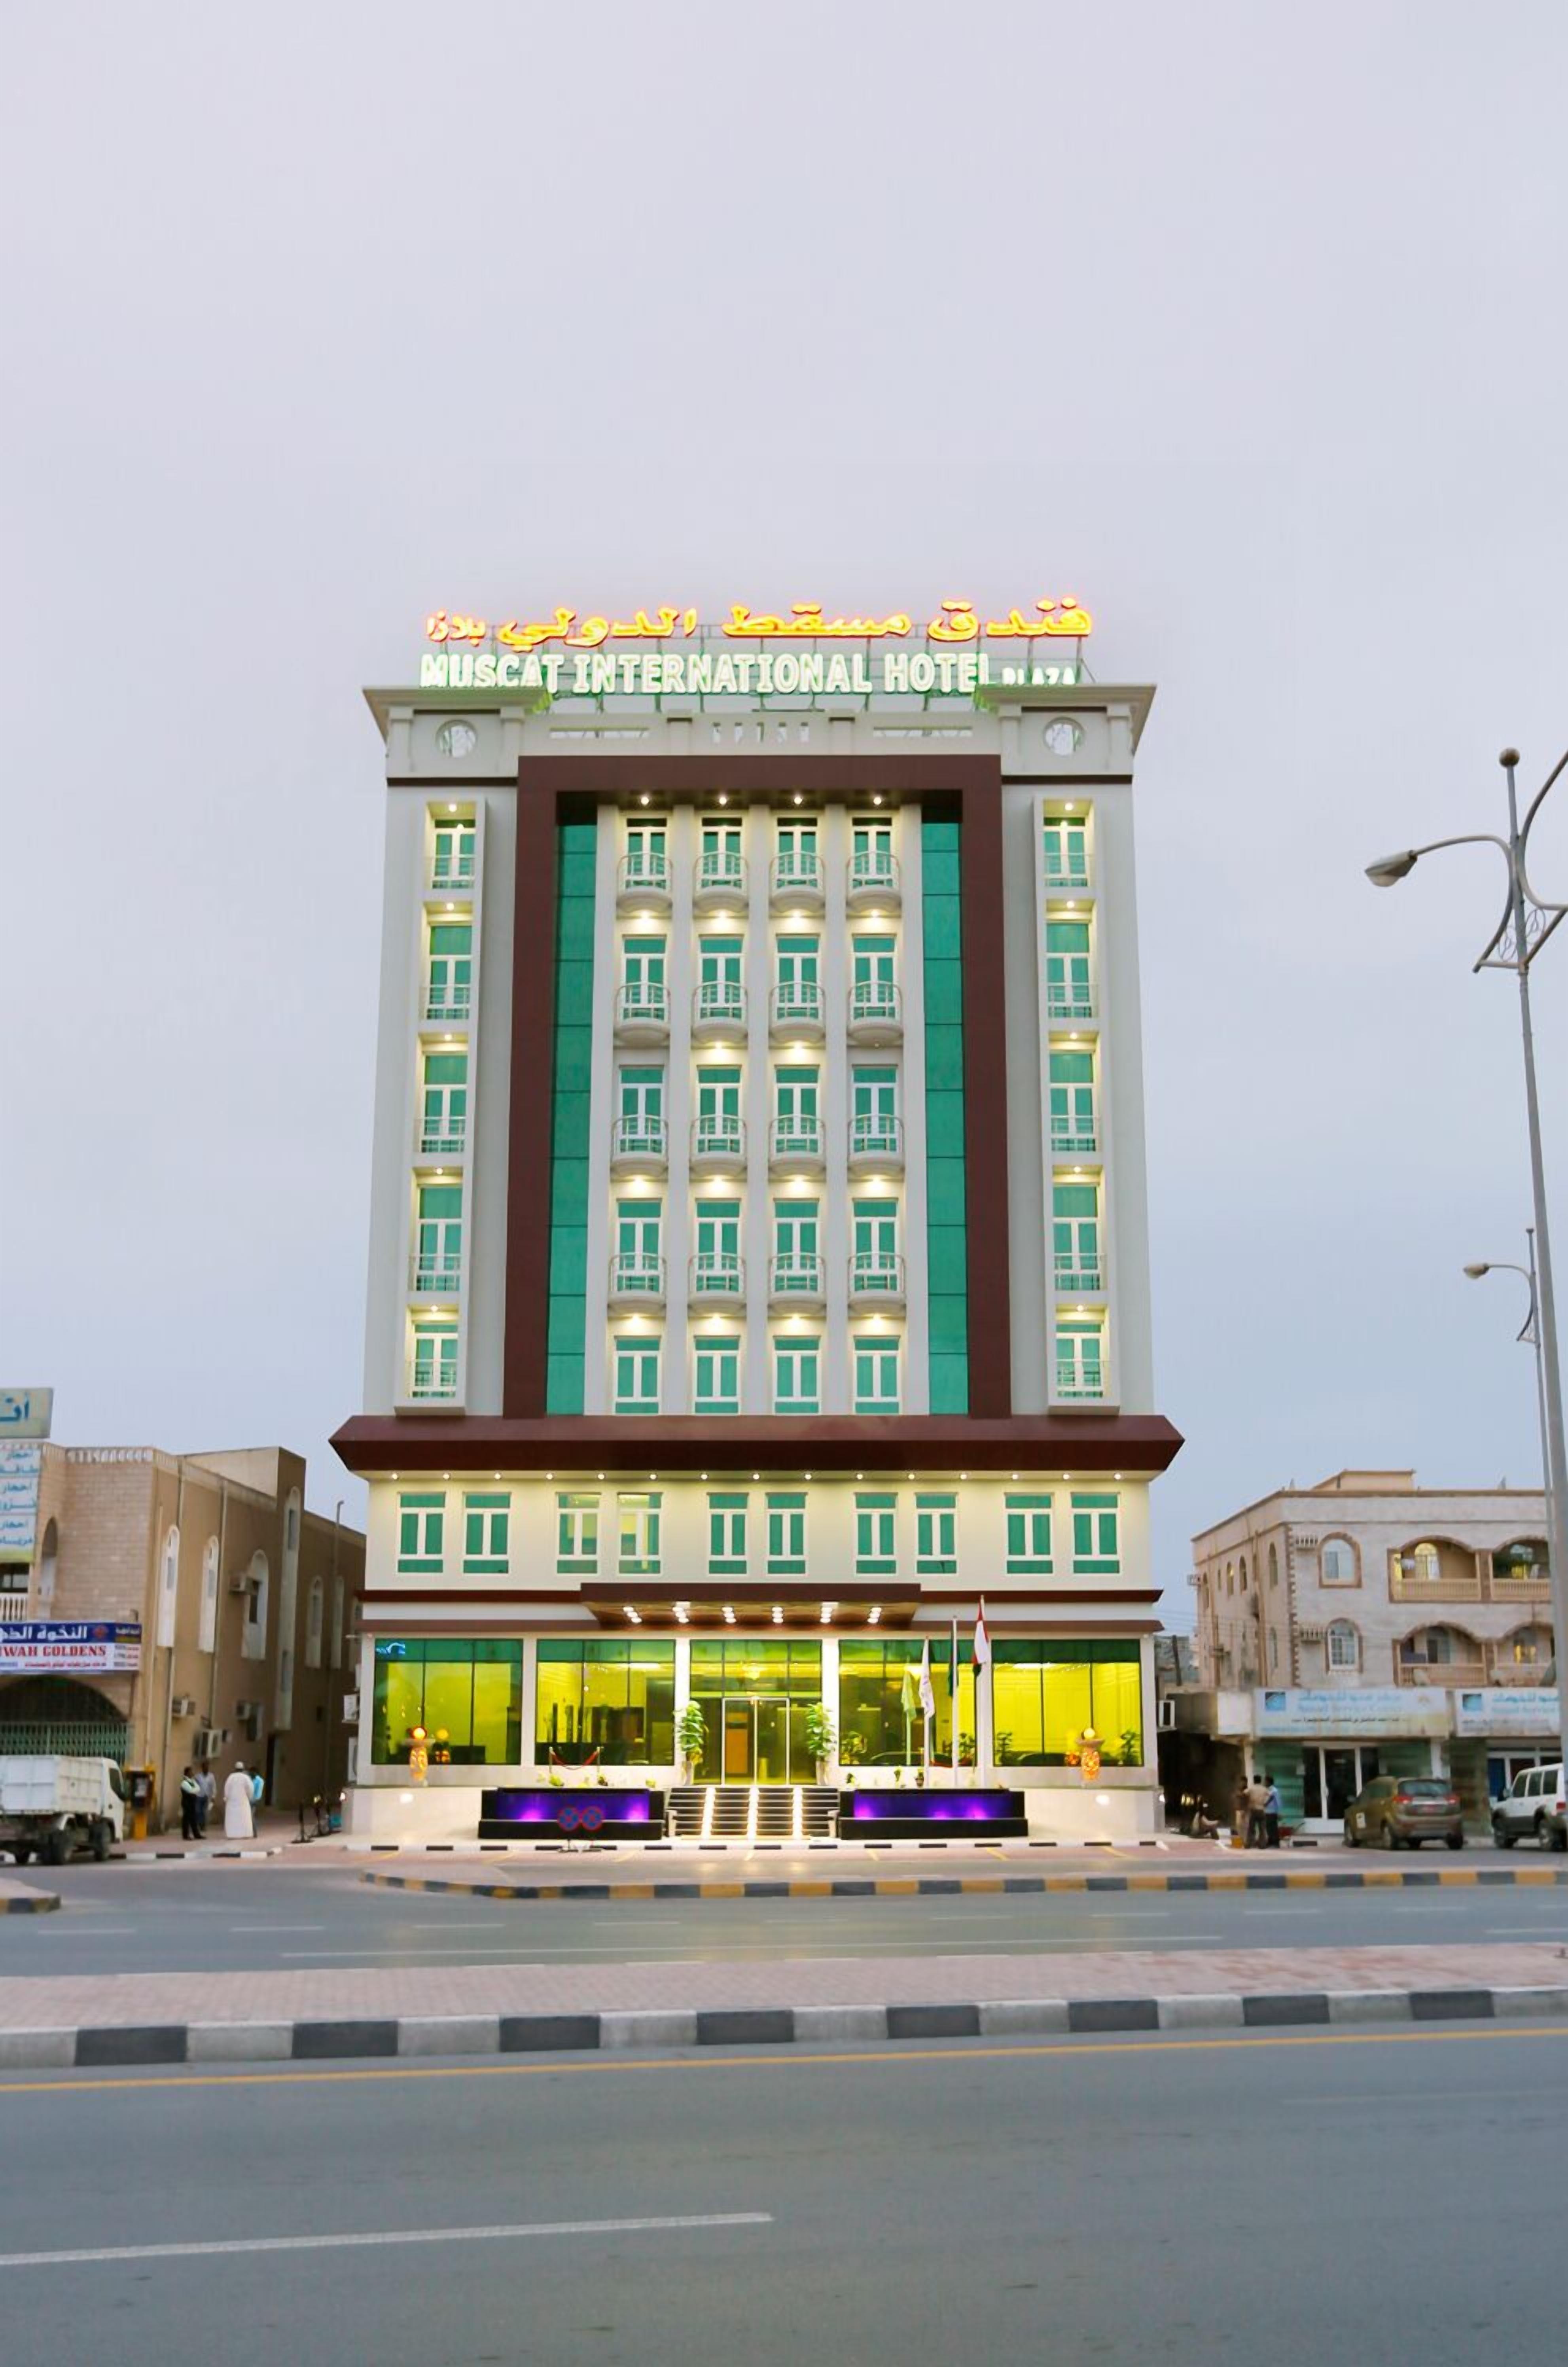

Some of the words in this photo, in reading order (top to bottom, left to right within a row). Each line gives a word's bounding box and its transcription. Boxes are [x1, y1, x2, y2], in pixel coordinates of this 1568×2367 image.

[426, 610, 486, 648] بلازا
[497, 607, 698, 653] الدولي
[721, 603, 912, 638] مسقط
[926, 596, 1092, 642] فندق
[419, 653, 565, 693] MUSCAT
[572, 653, 873, 693] INTERNATIONAL
[884, 653, 997, 693] HOTEL
[0, 1646, 38, 1657] WAH
[43, 1646, 106, 1656] GOLDENS
